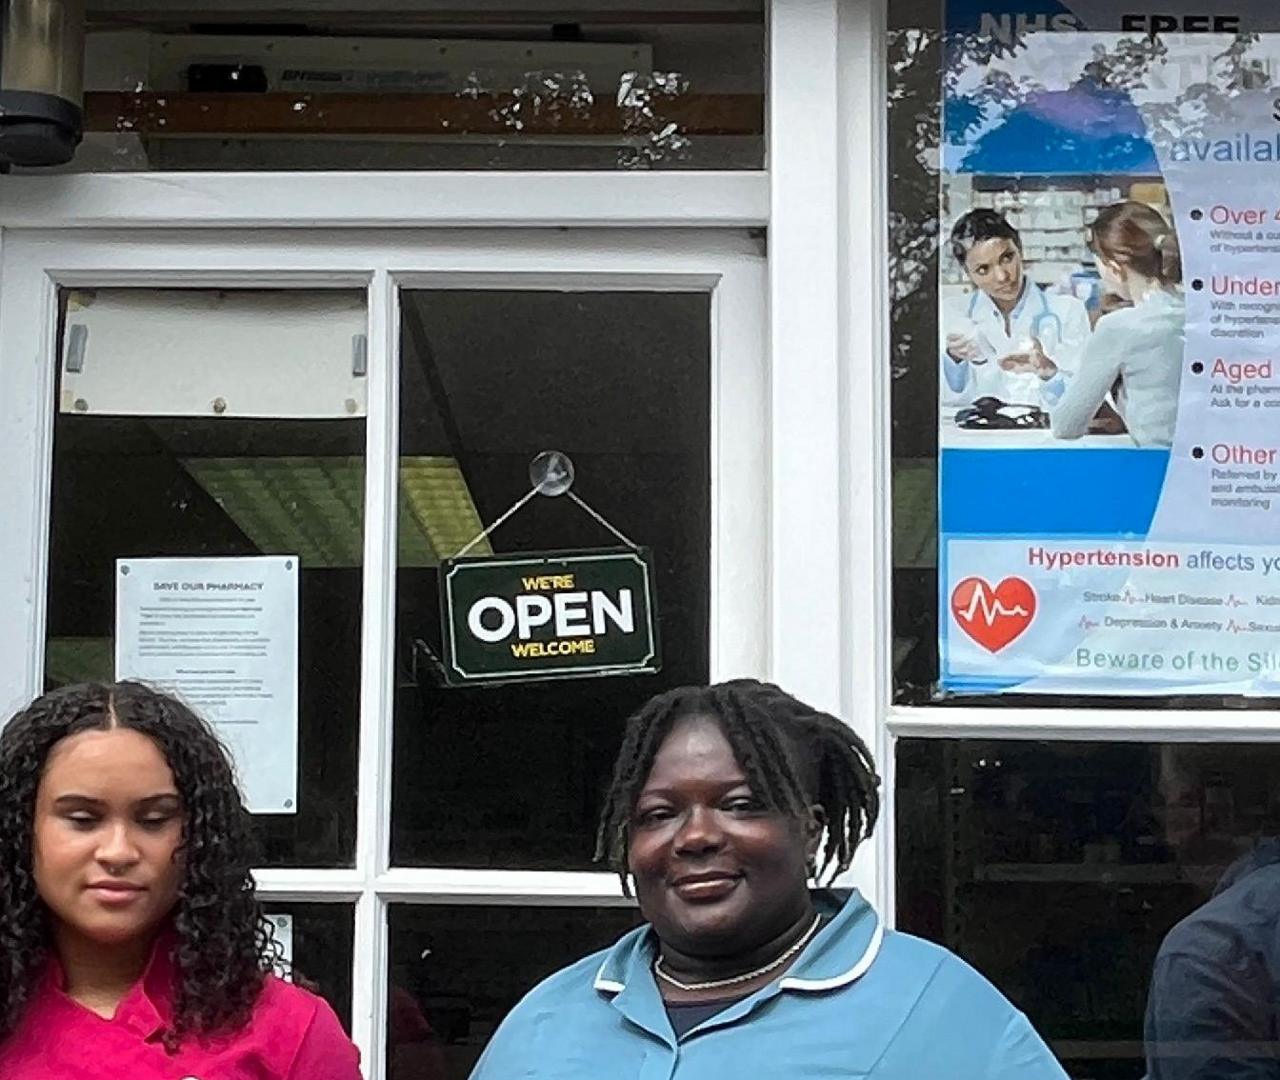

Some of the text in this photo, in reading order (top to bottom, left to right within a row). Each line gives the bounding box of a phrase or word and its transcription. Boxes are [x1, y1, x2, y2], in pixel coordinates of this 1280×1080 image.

[1210, 205, 1267, 225] Over
[1210, 230, 1253, 240] Without
[1210, 301, 1236, 311] With
[1211, 358, 1272, 384] Aged
[1226, 385, 1244, 394] the
[1210, 399, 1232, 408] Ask
[1235, 399, 1250, 408] for
[1211, 443, 1277, 464] Other
[1211, 469, 1261, 480] Referred
[1263, 469, 1278, 482] by
[1028, 547, 1179, 570] Hypertension
[1187, 550, 1256, 571] affects
[153, 582, 265, 591] SAVE OUR PHARMACY
[522, 574, 575, 591] WE'RE
[1083, 591, 1121, 602] Stroke
[1145, 593, 1176, 604] Heart
[1178, 593, 1223, 605] Disease
[467, 588, 635, 643] OPEN
[1104, 616, 1168, 628] Depression
[1170, 618, 1179, 629] &
[1181, 618, 1223, 631] Anxiety
[511, 638, 595, 659] WELCOME
[1076, 648, 1164, 670] Beware
[1172, 651, 1195, 670] of
[1202, 652, 1239, 672] the
